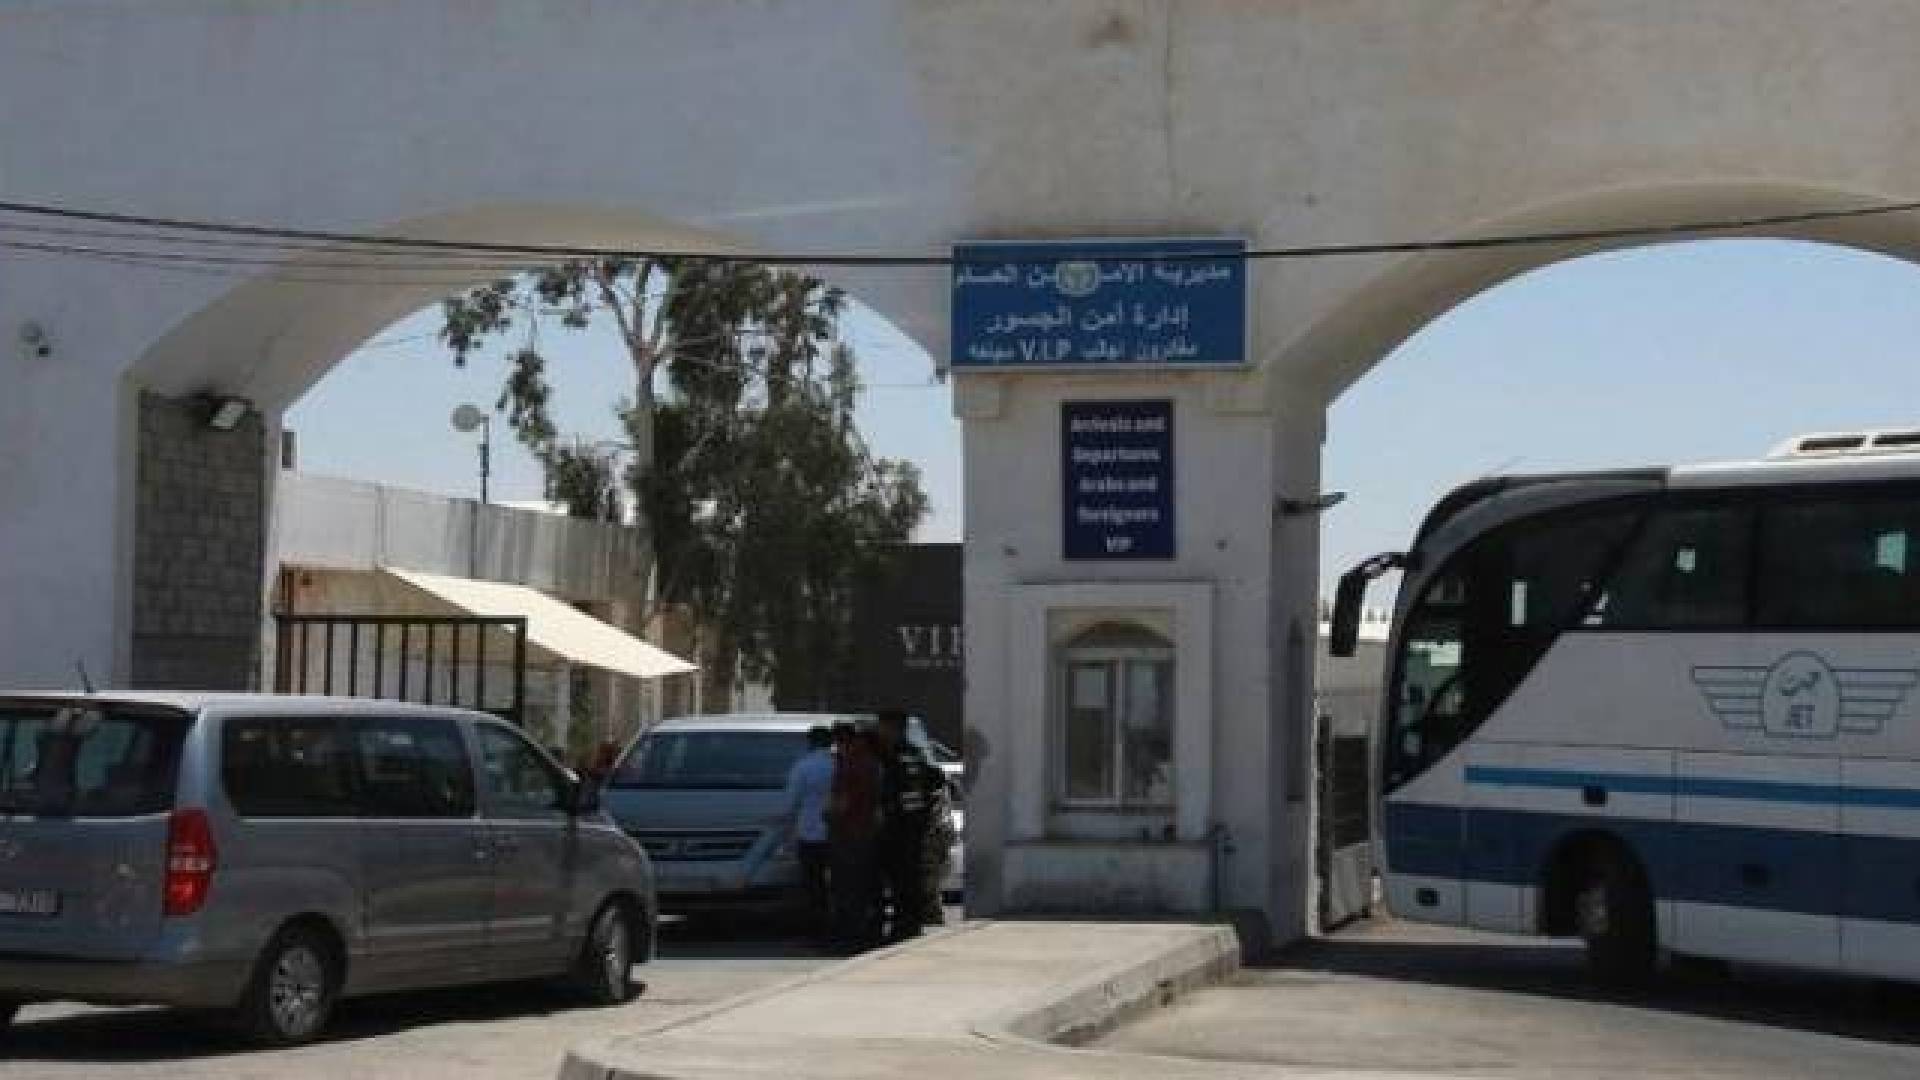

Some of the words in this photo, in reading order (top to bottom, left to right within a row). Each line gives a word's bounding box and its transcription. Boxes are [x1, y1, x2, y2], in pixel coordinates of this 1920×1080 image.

[986, 304, 1072, 334] الجسور
[1019, 337, 1072, 361] V.I.P
[1136, 416, 1166, 432] and
[1072, 447, 1160, 465] Departures
[1127, 476, 1158, 492] and
[1106, 537, 1133, 553] VIP
[1784, 704, 1816, 729] JET
